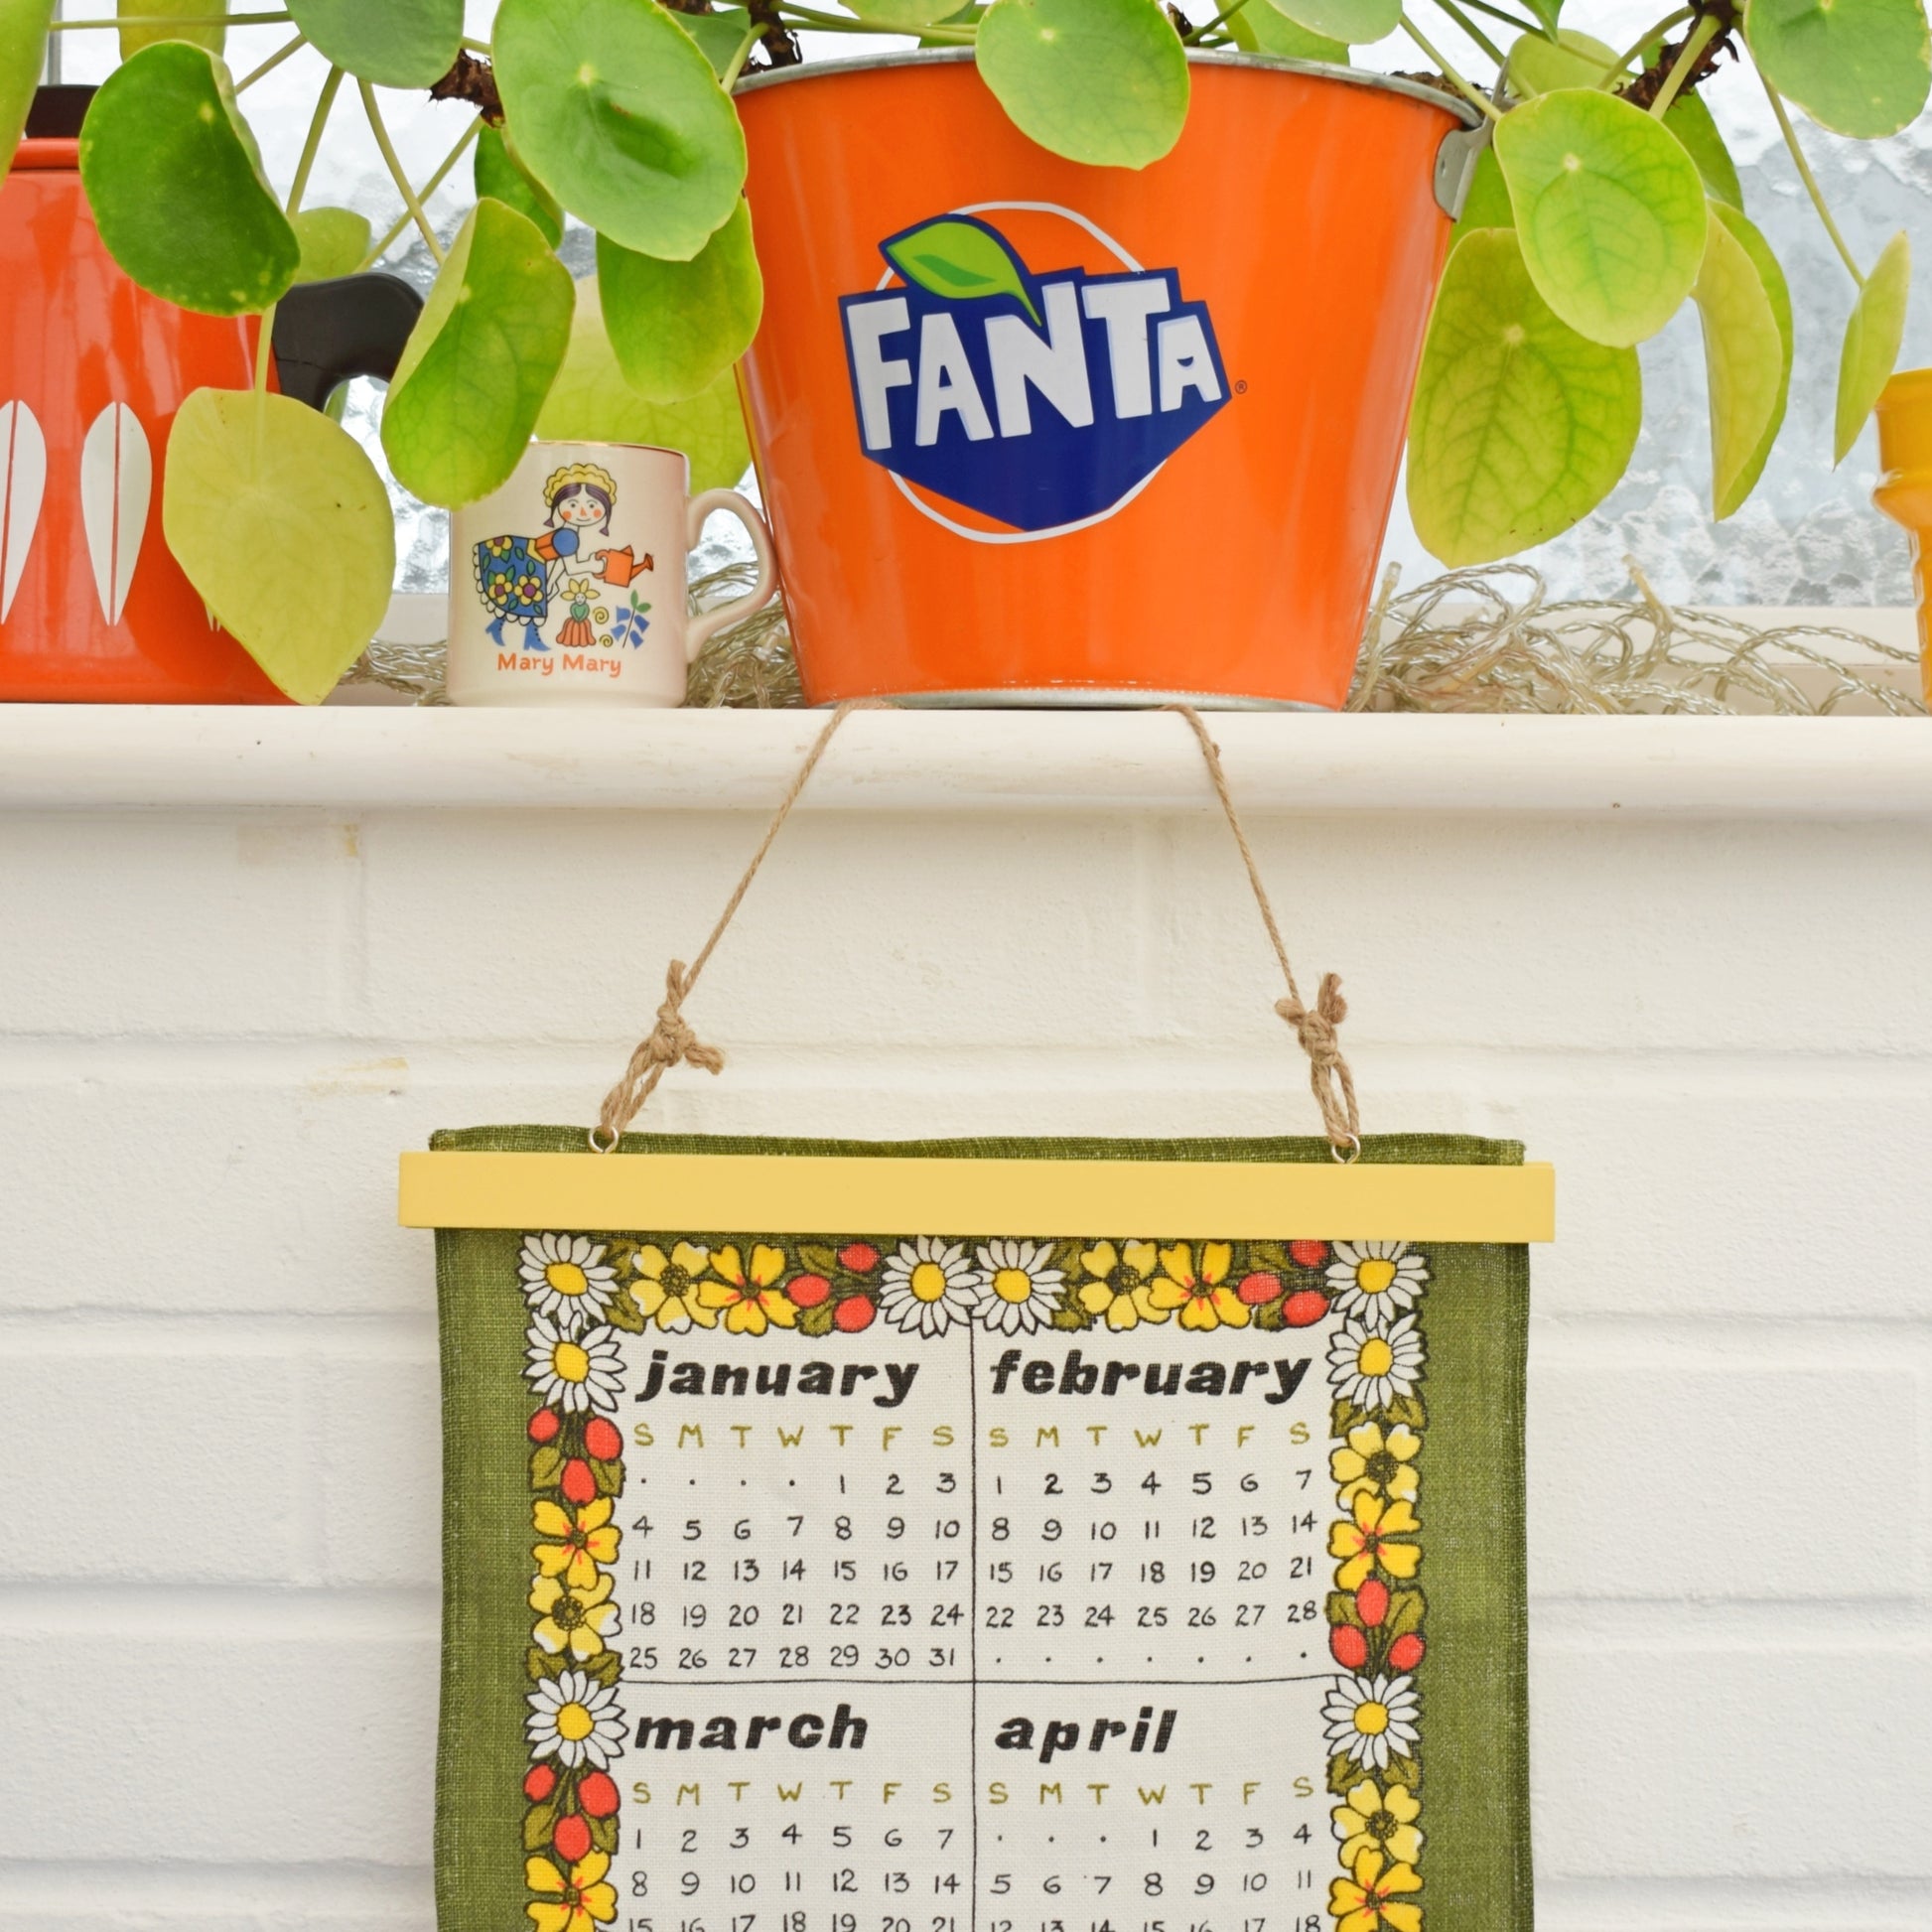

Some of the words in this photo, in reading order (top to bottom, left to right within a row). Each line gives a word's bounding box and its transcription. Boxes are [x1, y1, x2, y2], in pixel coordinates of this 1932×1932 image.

[846, 277, 1222, 451] FANTA
[497, 652, 554, 676] Mary
[562, 653, 621, 678] Mary
[634, 1349, 919, 1408] january
[990, 1349, 1312, 1405] february
[634, 1423, 654, 1447] S
[678, 1424, 704, 1449] M
[730, 1425, 753, 1449] T
[777, 1426, 804, 1449] W
[829, 1424, 854, 1447] T
[883, 1426, 902, 1451] F
[933, 1426, 954, 1447] S
[989, 1428, 1009, 1448] S
[1036, 1426, 1059, 1448] M
[1086, 1426, 1108, 1446] T
[1134, 1429, 1162, 1448] W
[1188, 1424, 1209, 1446] T
[1237, 1425, 1255, 1448] F
[1290, 1422, 1311, 1445] S
[839, 1473, 846, 1495] 1
[886, 1473, 904, 1495] 2
[936, 1472, 956, 1493] 3
[996, 1475, 1003, 1495] 1
[1044, 1473, 1063, 1495] 2
[1091, 1472, 1112, 1494] 3
[1141, 1470, 1162, 1495] 4
[1192, 1472, 1212, 1495] 5
[1240, 1473, 1259, 1492] 6
[1296, 1469, 1311, 1490] 7
[632, 1515, 653, 1538] 4
[683, 1519, 702, 1541] 5
[734, 1519, 751, 1540] 6
[787, 1515, 803, 1537] 7
[835, 1515, 852, 1541] 8
[887, 1516, 905, 1539] 9
[935, 1520, 960, 1539] 10
[992, 1517, 1010, 1541] 8
[1041, 1518, 1062, 1541] 9
[1091, 1521, 1117, 1541] 10
[1145, 1521, 1160, 1540] 11
[1192, 1516, 1216, 1539] 12
[1242, 1516, 1268, 1536] 13
[1293, 1510, 1317, 1534] 14
[634, 1560, 650, 1581] 11
[684, 1561, 707, 1582] 12
[735, 1559, 759, 1583] 13
[783, 1559, 806, 1581] 14
[834, 1560, 856, 1581] 15
[884, 1562, 907, 1582] 16
[937, 1561, 958, 1581] 17
[990, 1562, 1013, 1584] 15
[1039, 1562, 1062, 1583] 16
[1091, 1562, 1113, 1582] 17
[1141, 1561, 1166, 1584] 18
[1191, 1561, 1215, 1584] 19
[1238, 1561, 1267, 1581] 20
[1290, 1557, 1311, 1579] 21
[632, 1601, 655, 1626] 18
[683, 1604, 706, 1628] 19
[729, 1604, 759, 1627] 20
[782, 1603, 802, 1625] 21
[830, 1603, 860, 1625] 22
[882, 1604, 911, 1626] 23
[930, 1603, 964, 1626] 24
[986, 1605, 1014, 1628] 22
[1036, 1604, 1064, 1626] 23
[1084, 1604, 1115, 1627] 24
[1138, 1606, 1168, 1627] 25
[1187, 1606, 1216, 1627] 26
[1235, 1604, 1266, 1626] 27
[1288, 1600, 1317, 1623] 28
[630, 1647, 657, 1670] 25
[678, 1648, 707, 1669] 26
[729, 1647, 757, 1667] 27
[779, 1645, 809, 1668] 28
[830, 1644, 859, 1667] 29
[875, 1648, 909, 1669] 30
[929, 1648, 954, 1667] 31
[633, 1704, 869, 1750] march
[995, 1706, 1178, 1763] april
[633, 1782, 651, 1804] S
[676, 1783, 700, 1806] M
[728, 1781, 751, 1802] T
[777, 1782, 802, 1802] W
[830, 1780, 853, 1800] T
[884, 1782, 901, 1804] F
[933, 1782, 952, 1803] S
[989, 1782, 1009, 1805] S
[1039, 1782, 1062, 1805] M
[1087, 1783, 1110, 1805] T
[1138, 1785, 1166, 1806] W
[1189, 1783, 1212, 1805] T
[1243, 1782, 1261, 1805] F
[1293, 1776, 1313, 1798] S
[635, 1828, 642, 1850] 1
[681, 1829, 697, 1853] 2
[730, 1828, 749, 1849] 3
[781, 1823, 802, 1845] 4
[833, 1826, 852, 1848] 5
[885, 1829, 902, 1847] 6
[938, 1829, 953, 1850] 7
[1152, 1828, 1159, 1848] 1
[1195, 1830, 1212, 1852] 2
[1246, 1828, 1263, 1848] 3
[1293, 1823, 1311, 1845] 4
[632, 1870, 647, 1896] 8
[681, 1871, 700, 1896] 9
[731, 1873, 756, 1893] 10
[786, 1871, 800, 1891] 11
[833, 1868, 858, 1892] 12
[885, 1872, 909, 1893] 13
[935, 1873, 960, 1894] 14
[990, 1874, 1011, 1894] 5
[1043, 1875, 1061, 1894] 6
[1094, 1876, 1112, 1894] 7
[1144, 1872, 1163, 1896] 8
[1194, 1873, 1214, 1895] 9
[1244, 1872, 1267, 1891] 10
[1299, 1869, 1311, 1888] 11
[629, 1918, 652, 1932] 15
[681, 1918, 705, 1932] 16
[733, 1914, 756, 1932] 17
[783, 1911, 806, 1932] 18
[833, 1913, 857, 1932] 19
[883, 1916, 910, 1932] 20
[932, 1916, 954, 1932] 21
